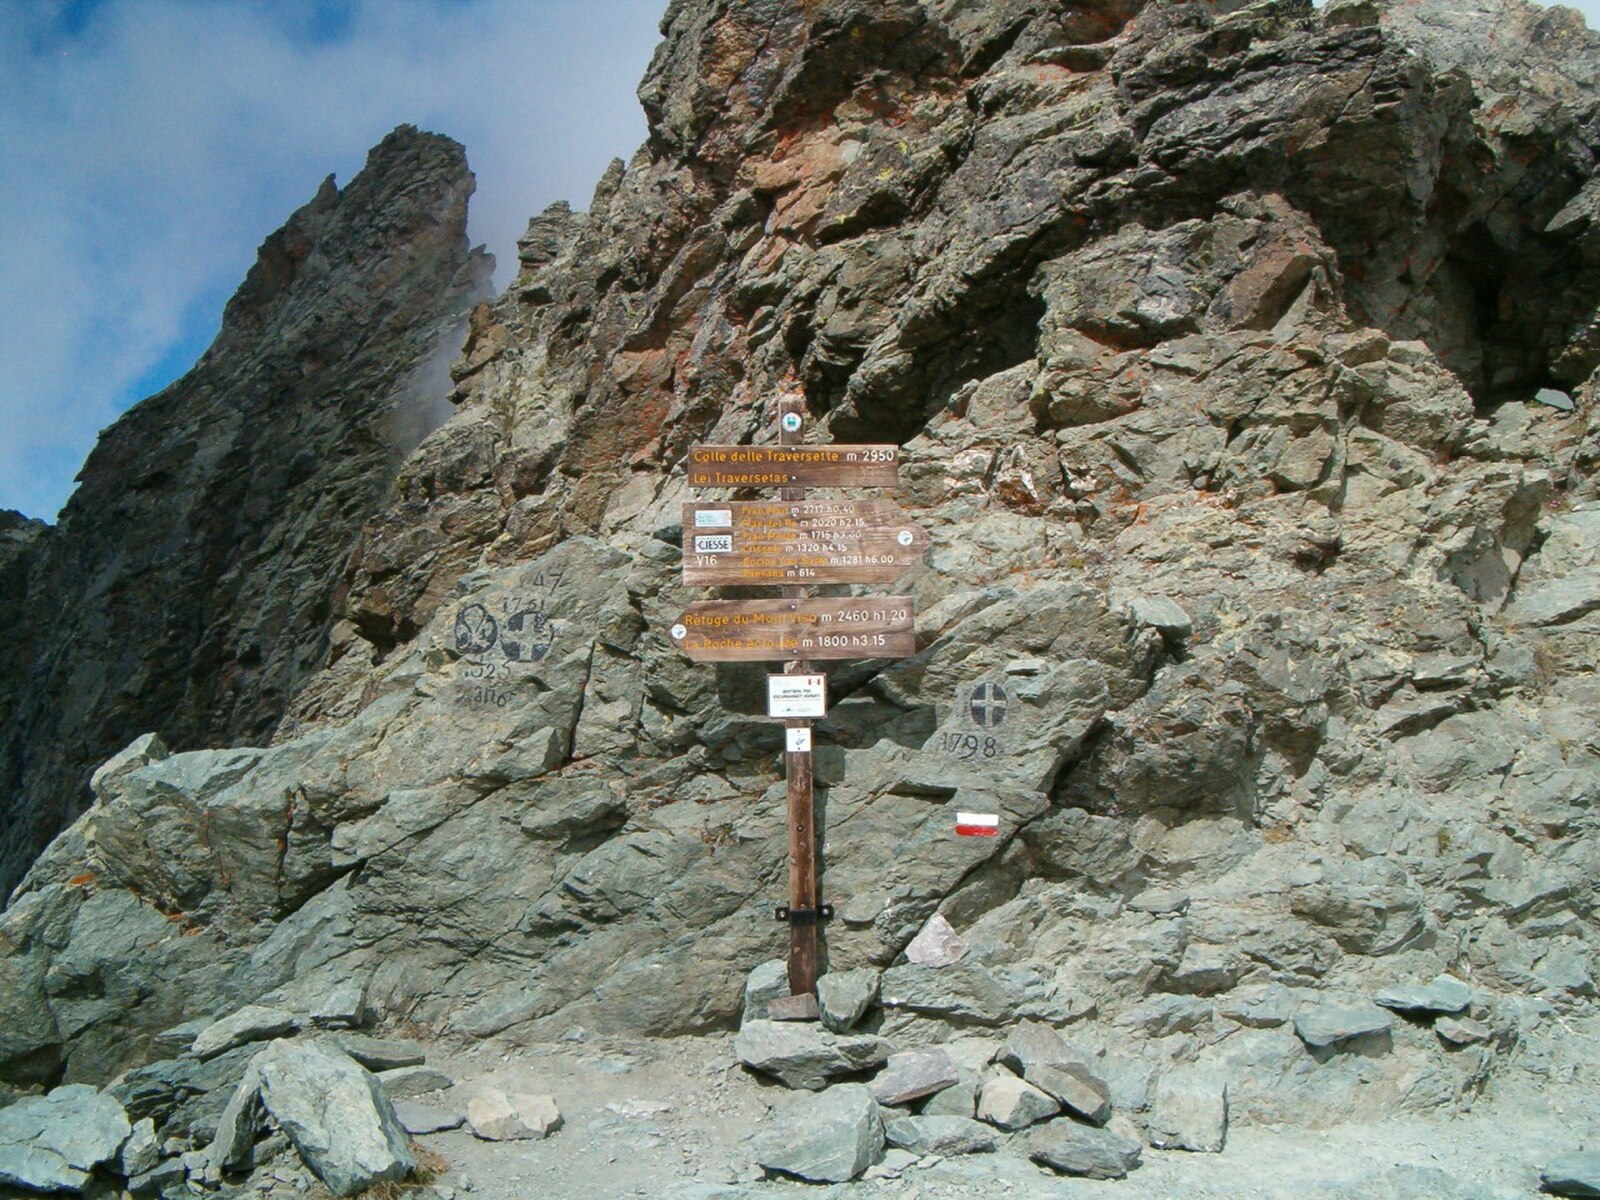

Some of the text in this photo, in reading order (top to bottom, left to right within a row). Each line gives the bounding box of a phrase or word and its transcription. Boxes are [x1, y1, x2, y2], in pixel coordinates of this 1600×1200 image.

[694, 450, 726, 462] Colle
[731, 450, 763, 462] delle
[767, 450, 839, 462] Traversette
[862, 450, 895, 462] 2950
[693, 472, 788, 484] Lei Traversetas
[812, 519, 836, 527] 2020
[698, 540, 729, 551] CIESSE
[798, 544, 819, 552] 1320
[696, 554, 718, 567] V16
[842, 556, 862, 564] 1281
[799, 569, 816, 577] 614
[685, 613, 730, 627] Refuge
[733, 614, 749, 624] du
[837, 611, 869, 622] 2460
[685, 639, 699, 650] La
[703, 638, 742, 649] Roche
[818, 636, 848, 647] 1800
[943, 732, 996, 760] 1798
